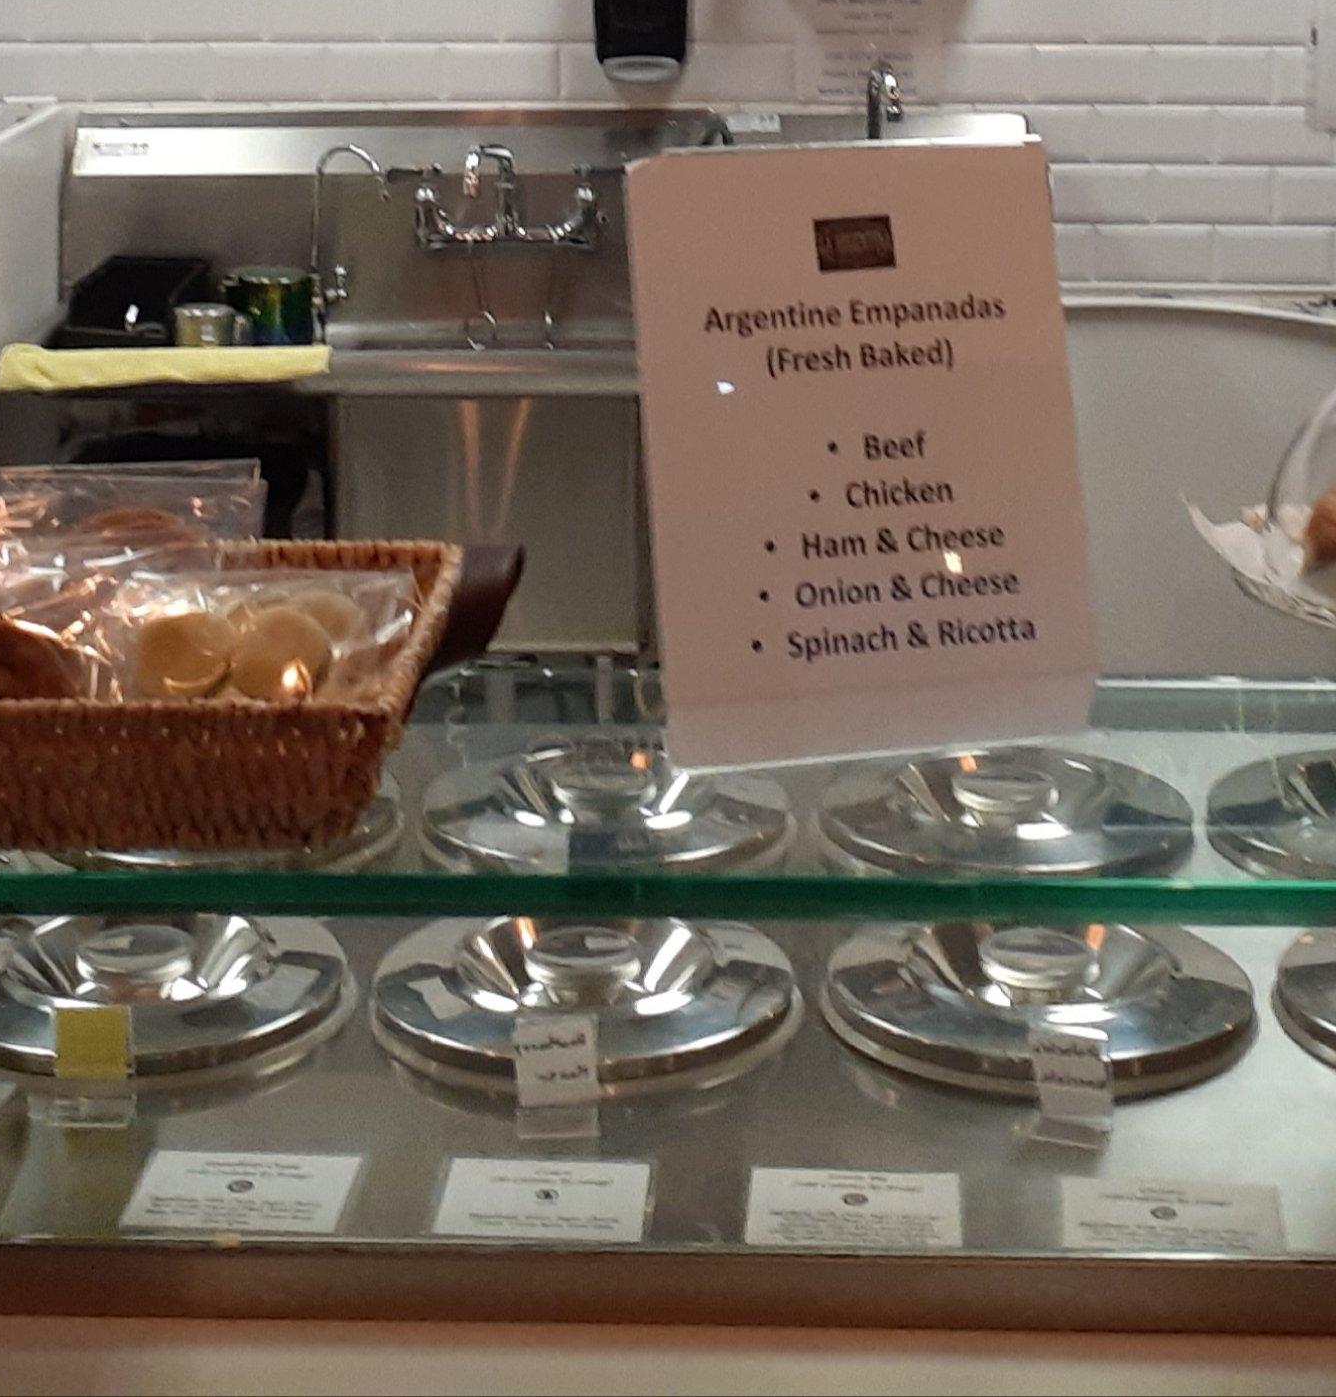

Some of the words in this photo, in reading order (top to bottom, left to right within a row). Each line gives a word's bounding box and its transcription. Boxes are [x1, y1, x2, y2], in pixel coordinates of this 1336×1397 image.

[703, 296, 843, 337] Argentine
[848, 291, 1007, 330] Empanadas
[765, 344, 852, 380] (Fresh
[860, 340, 955, 376] Baked)
[862, 428, 929, 462] Beef
[845, 477, 956, 511] Chicken
[800, 527, 868, 560] Ham
[876, 525, 900, 555] &
[906, 522, 1007, 554] Cheese
[794, 577, 882, 610] Onion
[889, 575, 914, 603] &
[919, 569, 1021, 602] Cheese
[787, 625, 900, 666] Spinach
[905, 622, 932, 652] &
[938, 615, 1038, 648] Ricotta
